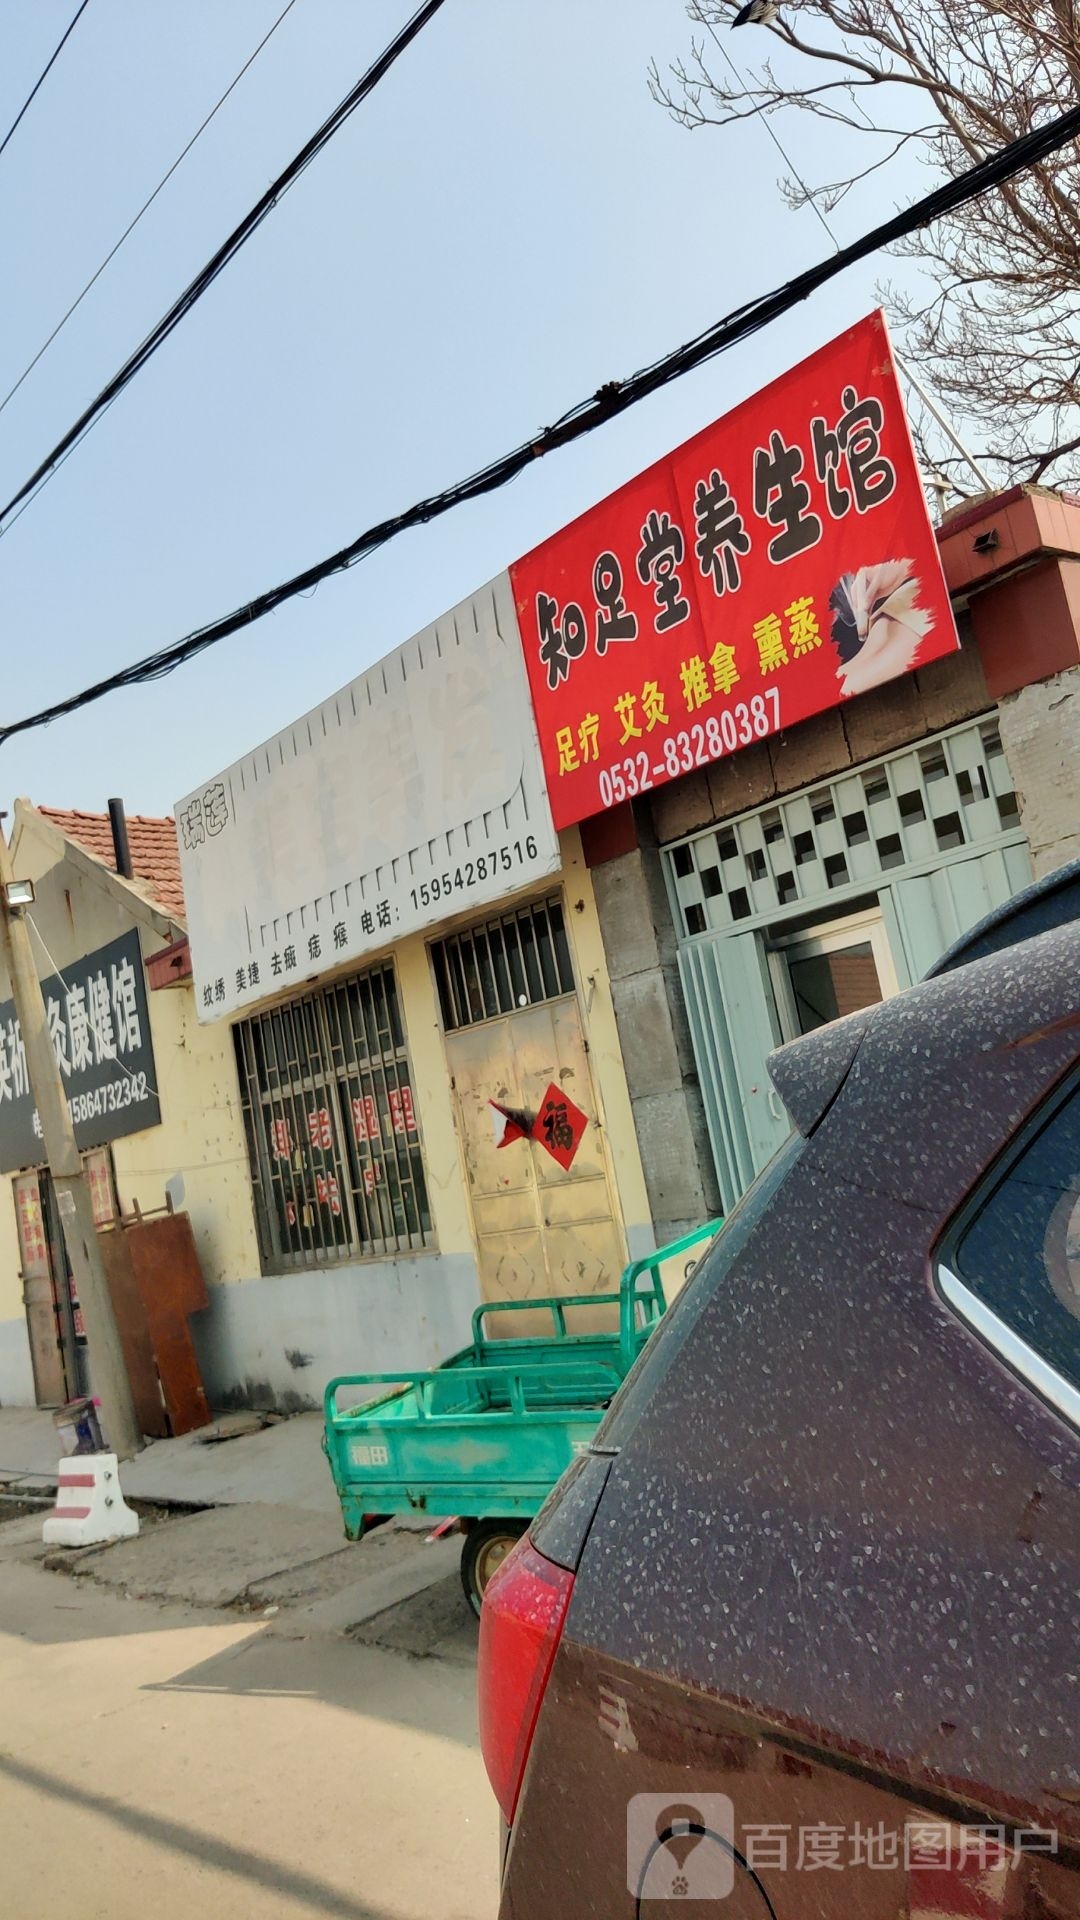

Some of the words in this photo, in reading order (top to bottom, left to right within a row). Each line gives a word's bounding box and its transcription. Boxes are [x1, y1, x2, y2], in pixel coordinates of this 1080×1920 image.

[535, 385, 897, 691] 知足堂养生馆
[555, 712, 600, 776] 足疗
[613, 680, 670, 746] 艾灸
[679, 641, 741, 712] 推拿
[752, 596, 823, 676] 熏蒸
[599, 686, 781, 808] 0532-83280387
[203, 977, 226, 1007] 纹绣
[308, 934, 322, 960] 痣
[410, 835, 538, 910] 15954287516
[67, 1071, 149, 1125] 15864732342
[543, 1101, 573, 1151] 福
